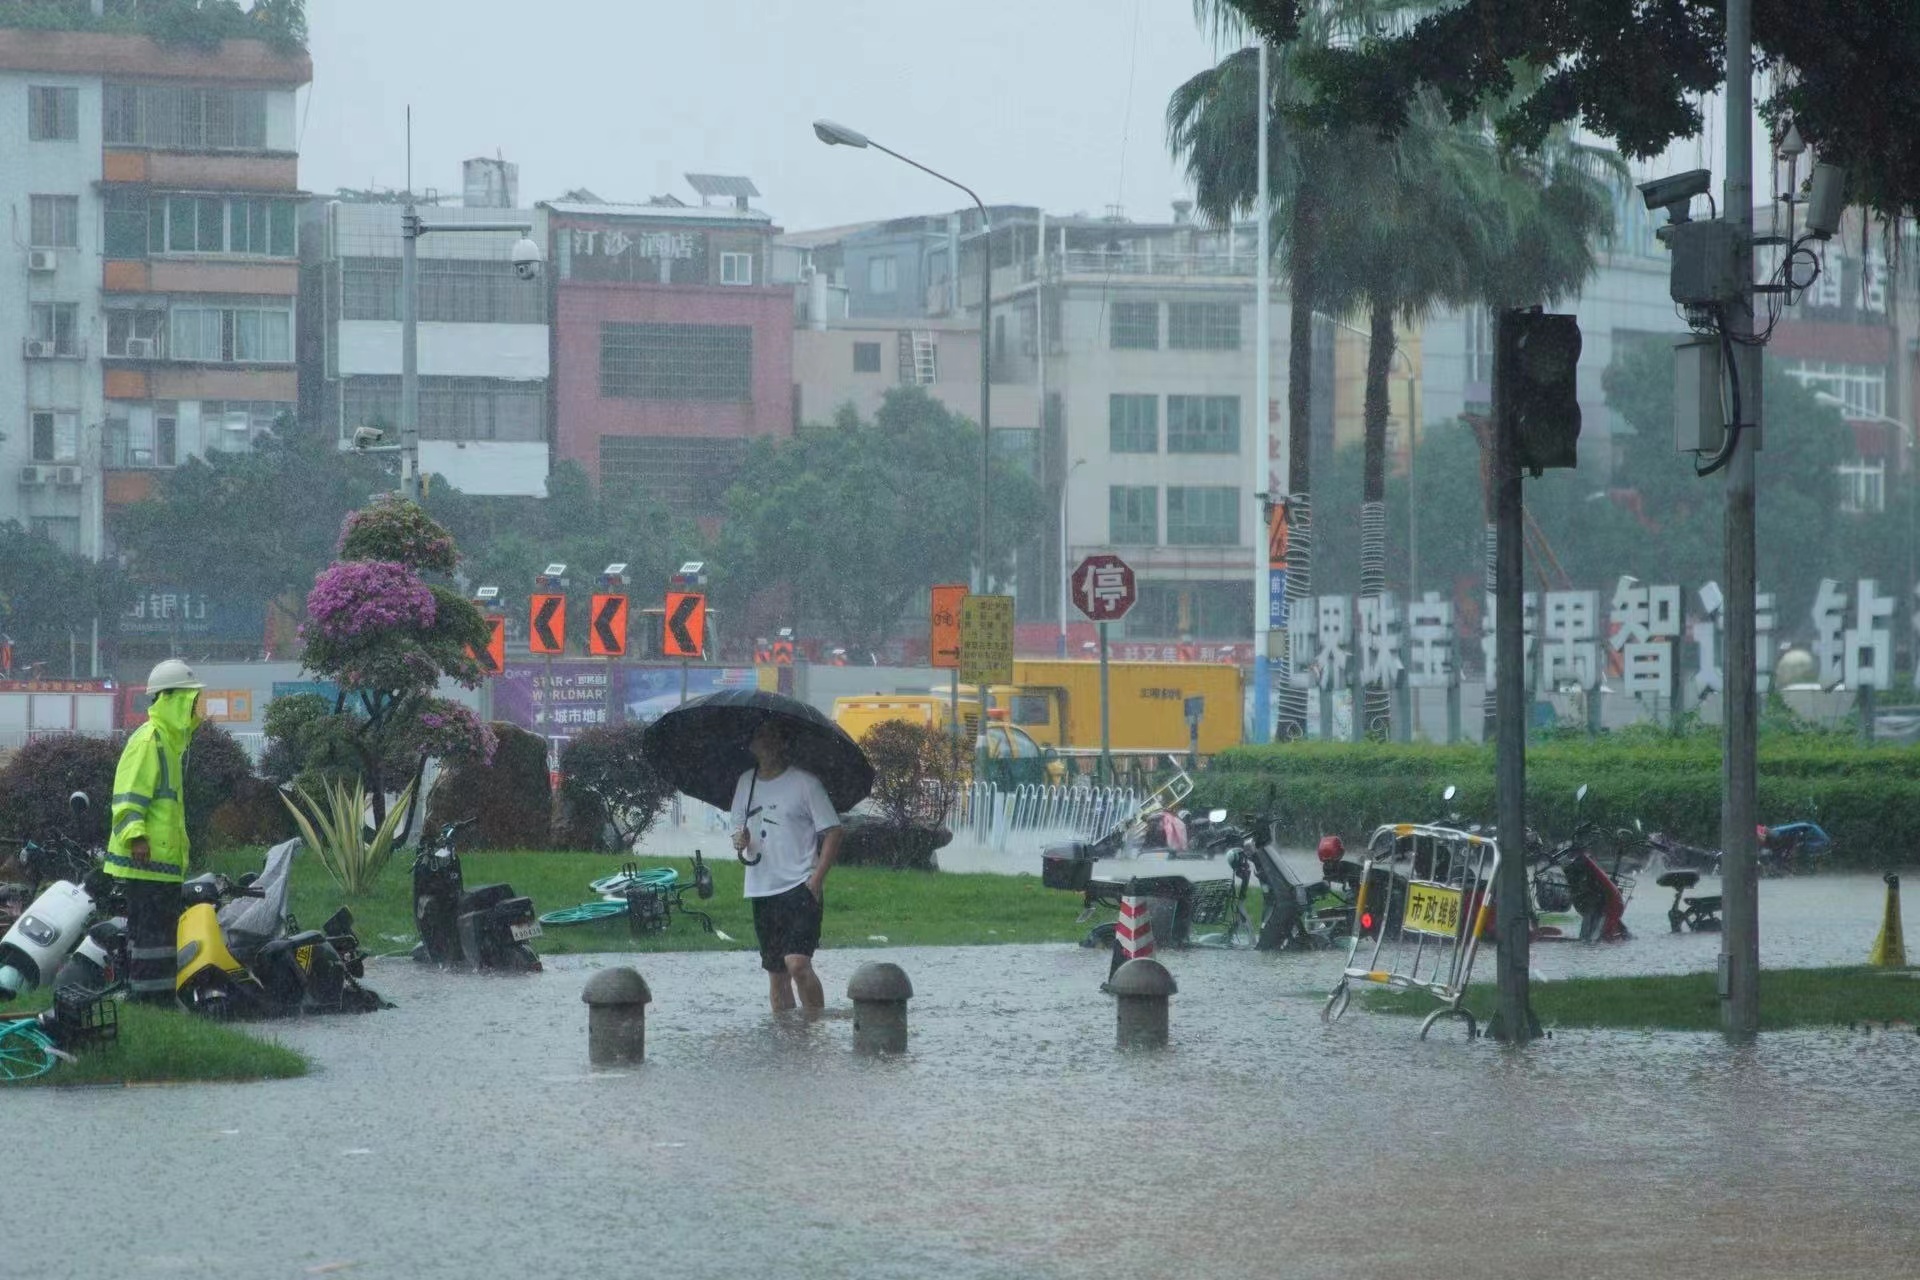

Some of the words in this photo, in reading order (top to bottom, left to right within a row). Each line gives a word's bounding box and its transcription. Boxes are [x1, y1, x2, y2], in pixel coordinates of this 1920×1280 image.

[1081, 563, 1127, 612] 停
[1288, 591, 1455, 690] 世界珠宝
[533, 690, 606, 701] WRLDMAR
[1412, 892, 1459, 929] 市政维修
